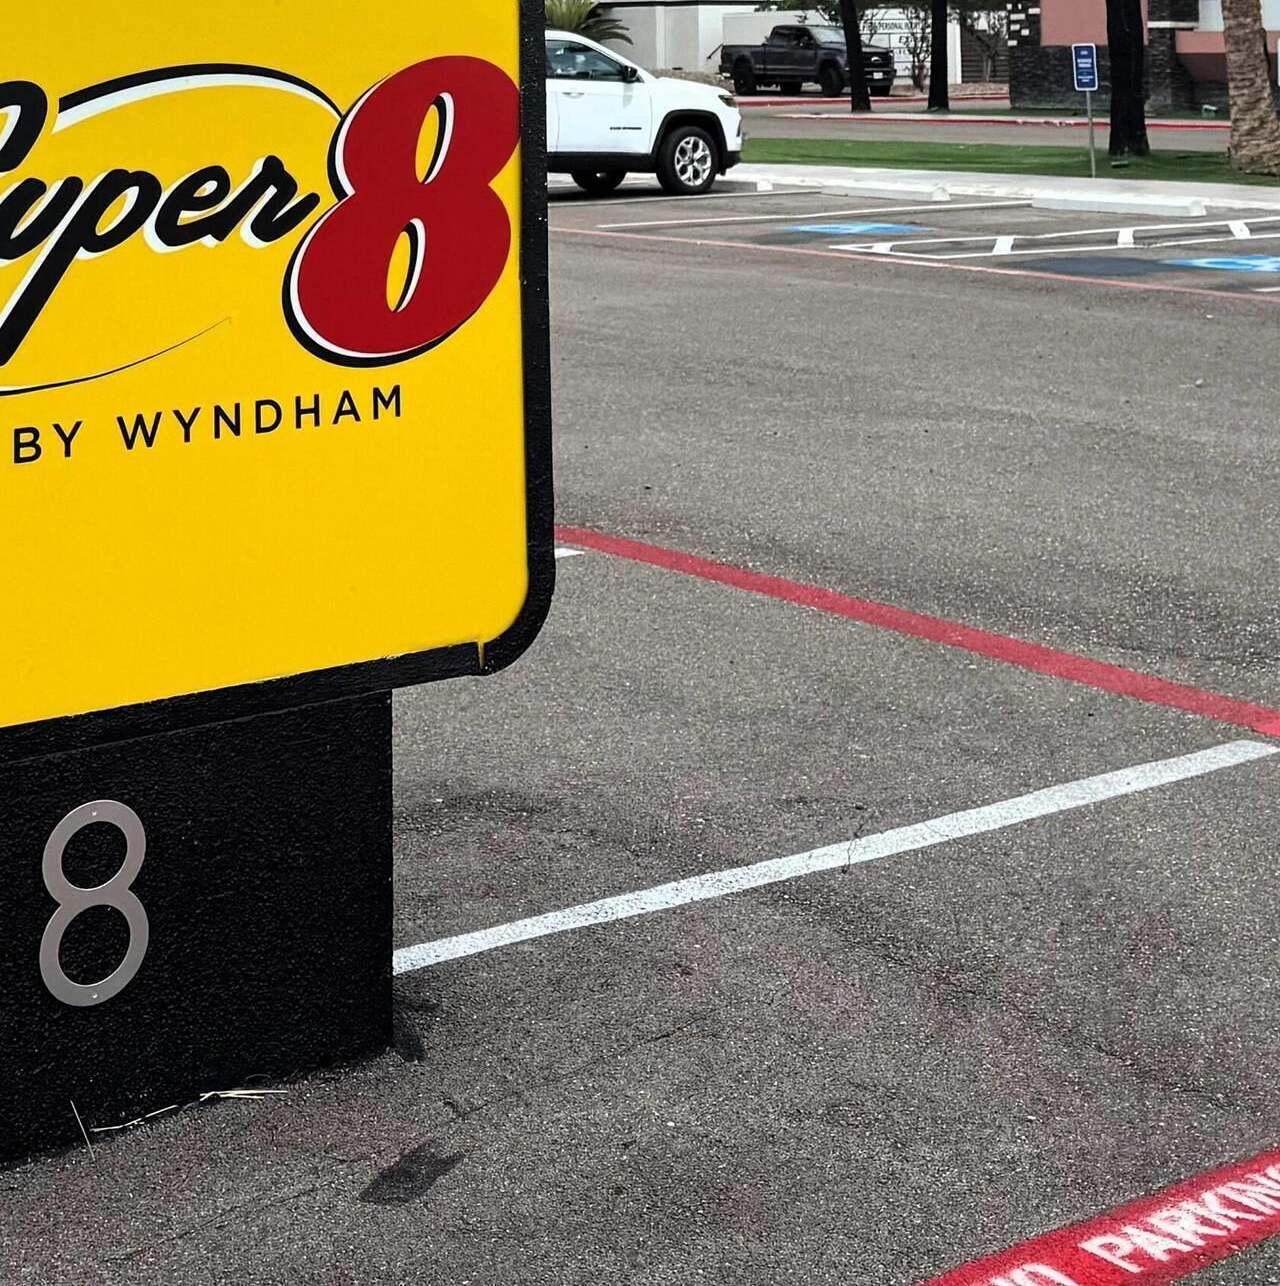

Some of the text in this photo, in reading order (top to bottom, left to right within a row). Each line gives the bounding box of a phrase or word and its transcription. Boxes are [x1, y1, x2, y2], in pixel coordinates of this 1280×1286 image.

[282, 54, 522, 369] 8
[12, 384, 403, 464] BY WYNDHAM
